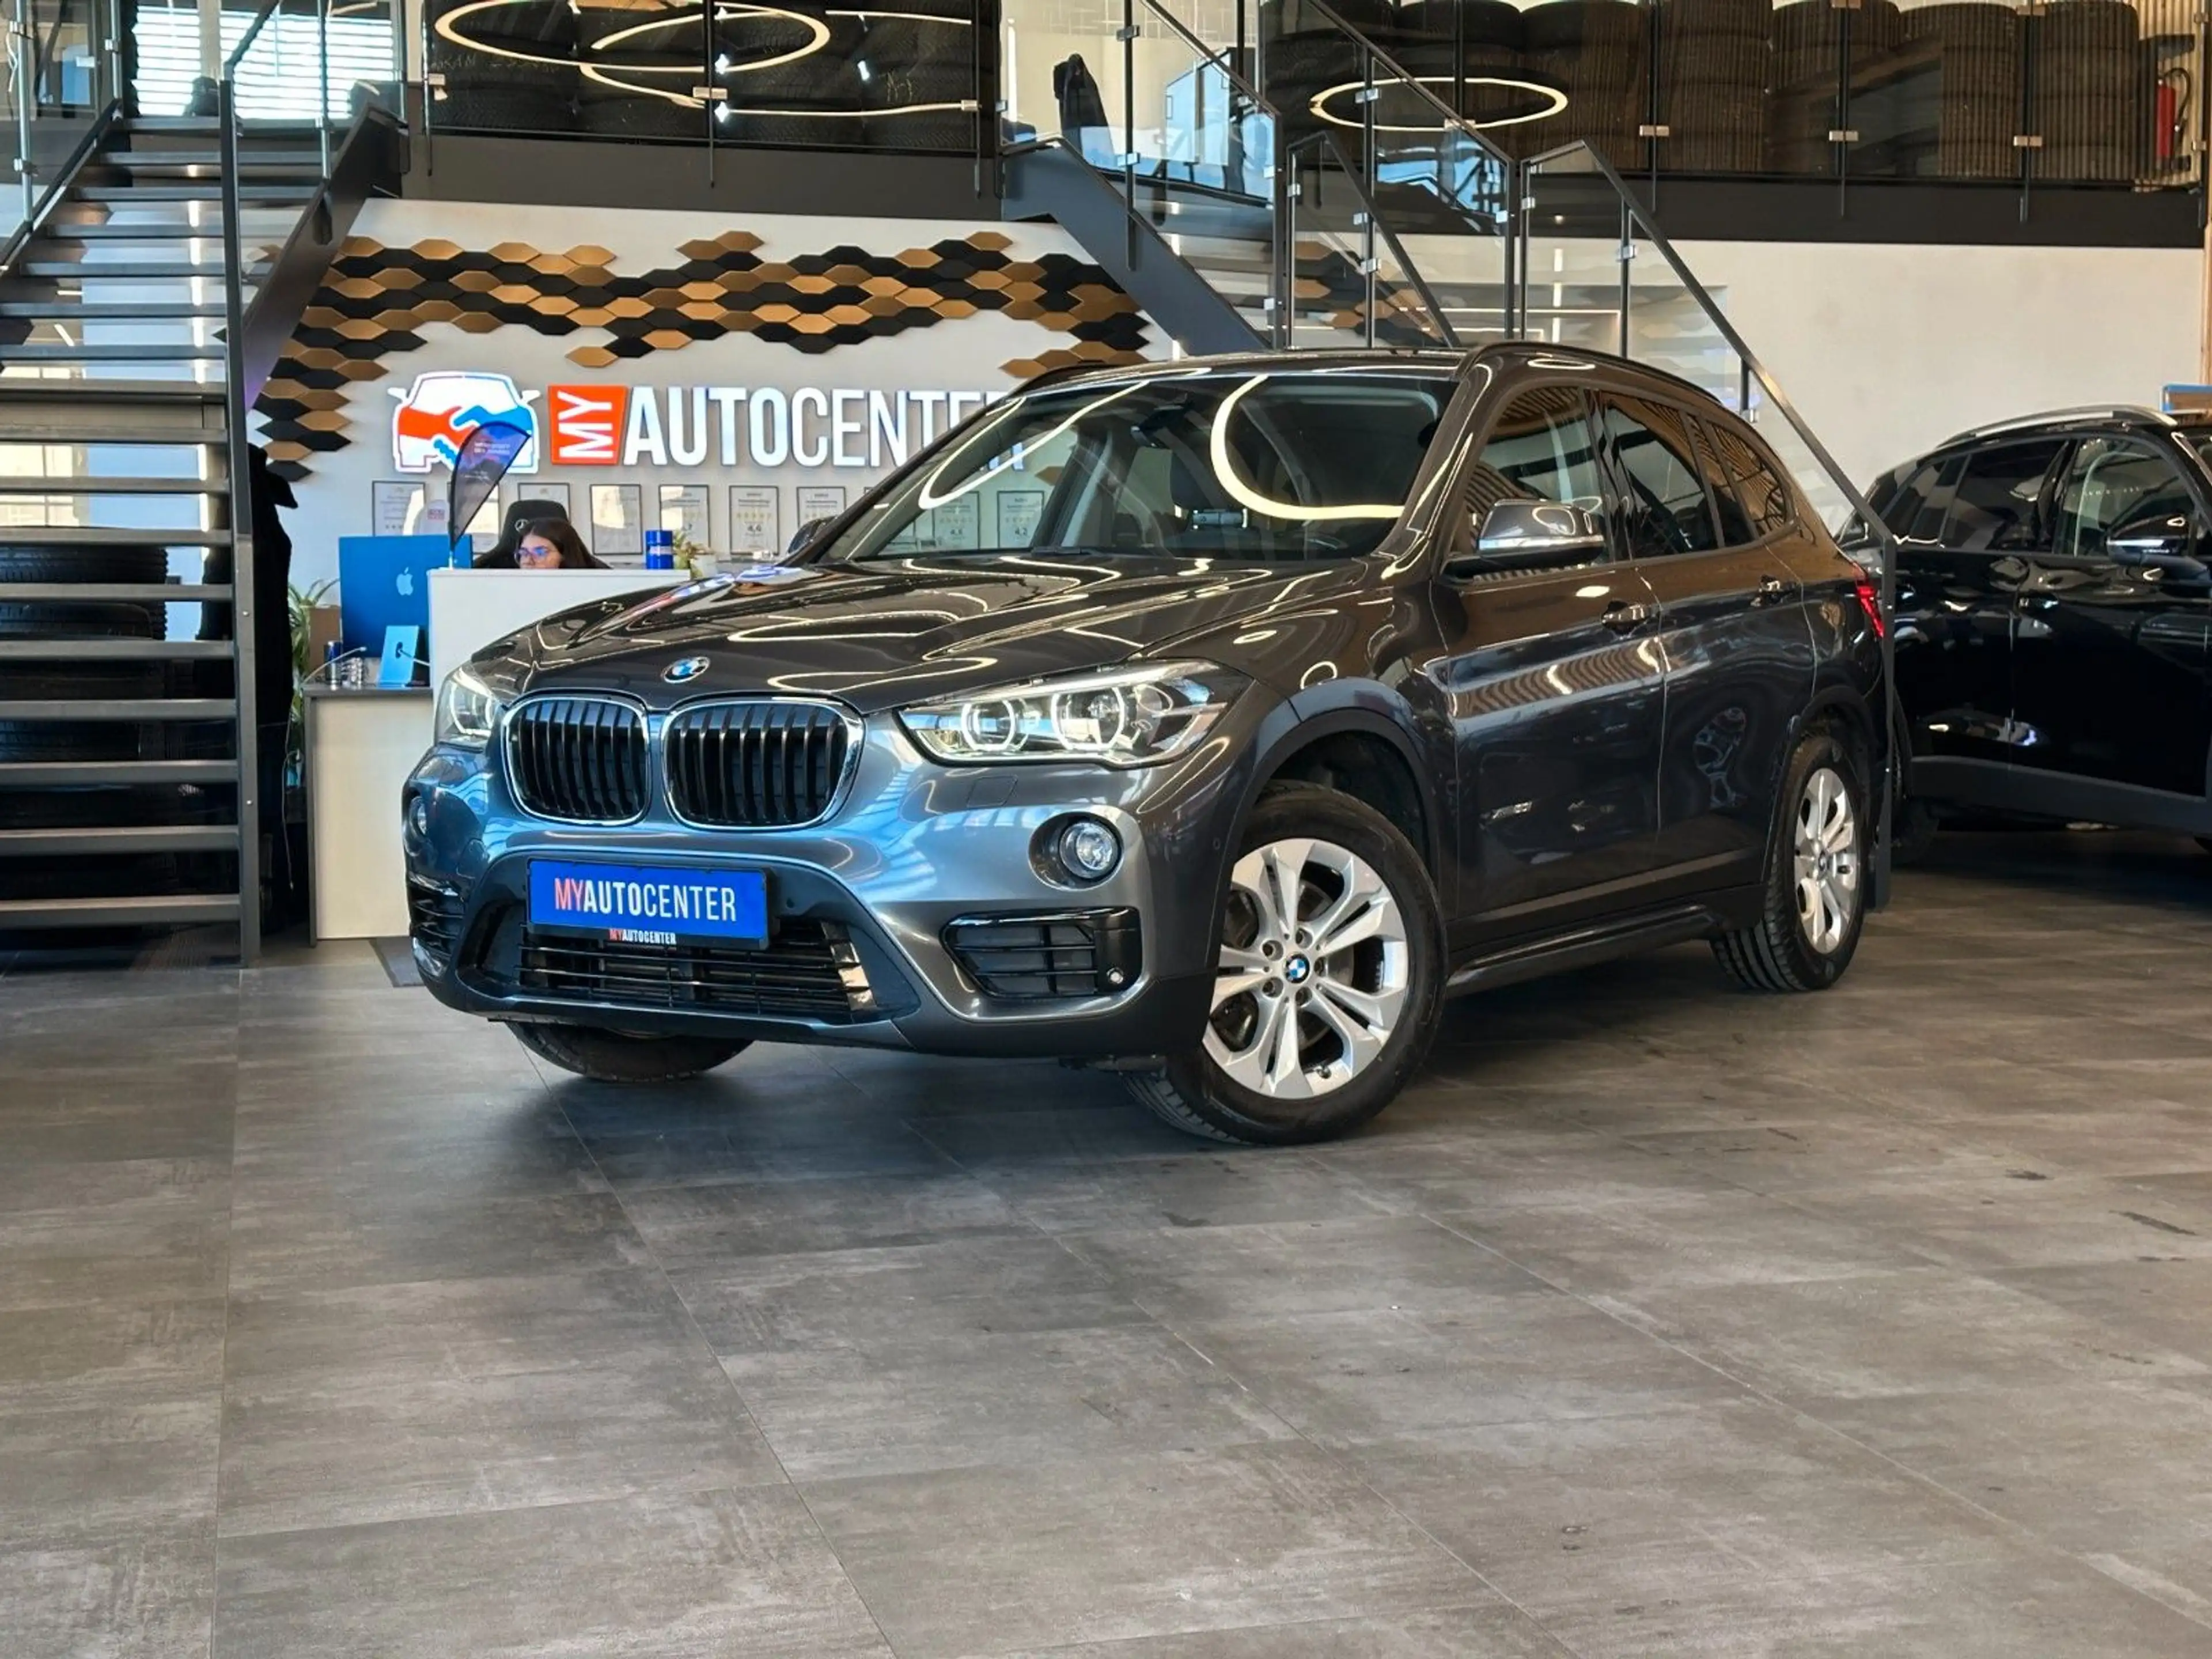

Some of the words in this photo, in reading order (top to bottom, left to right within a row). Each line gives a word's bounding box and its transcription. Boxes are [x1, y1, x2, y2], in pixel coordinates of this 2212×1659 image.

[557, 389, 613, 459] MY
[554, 877, 737, 922] MYAUTOCENTER
[609, 928, 676, 945] MYAUTOCENTER
